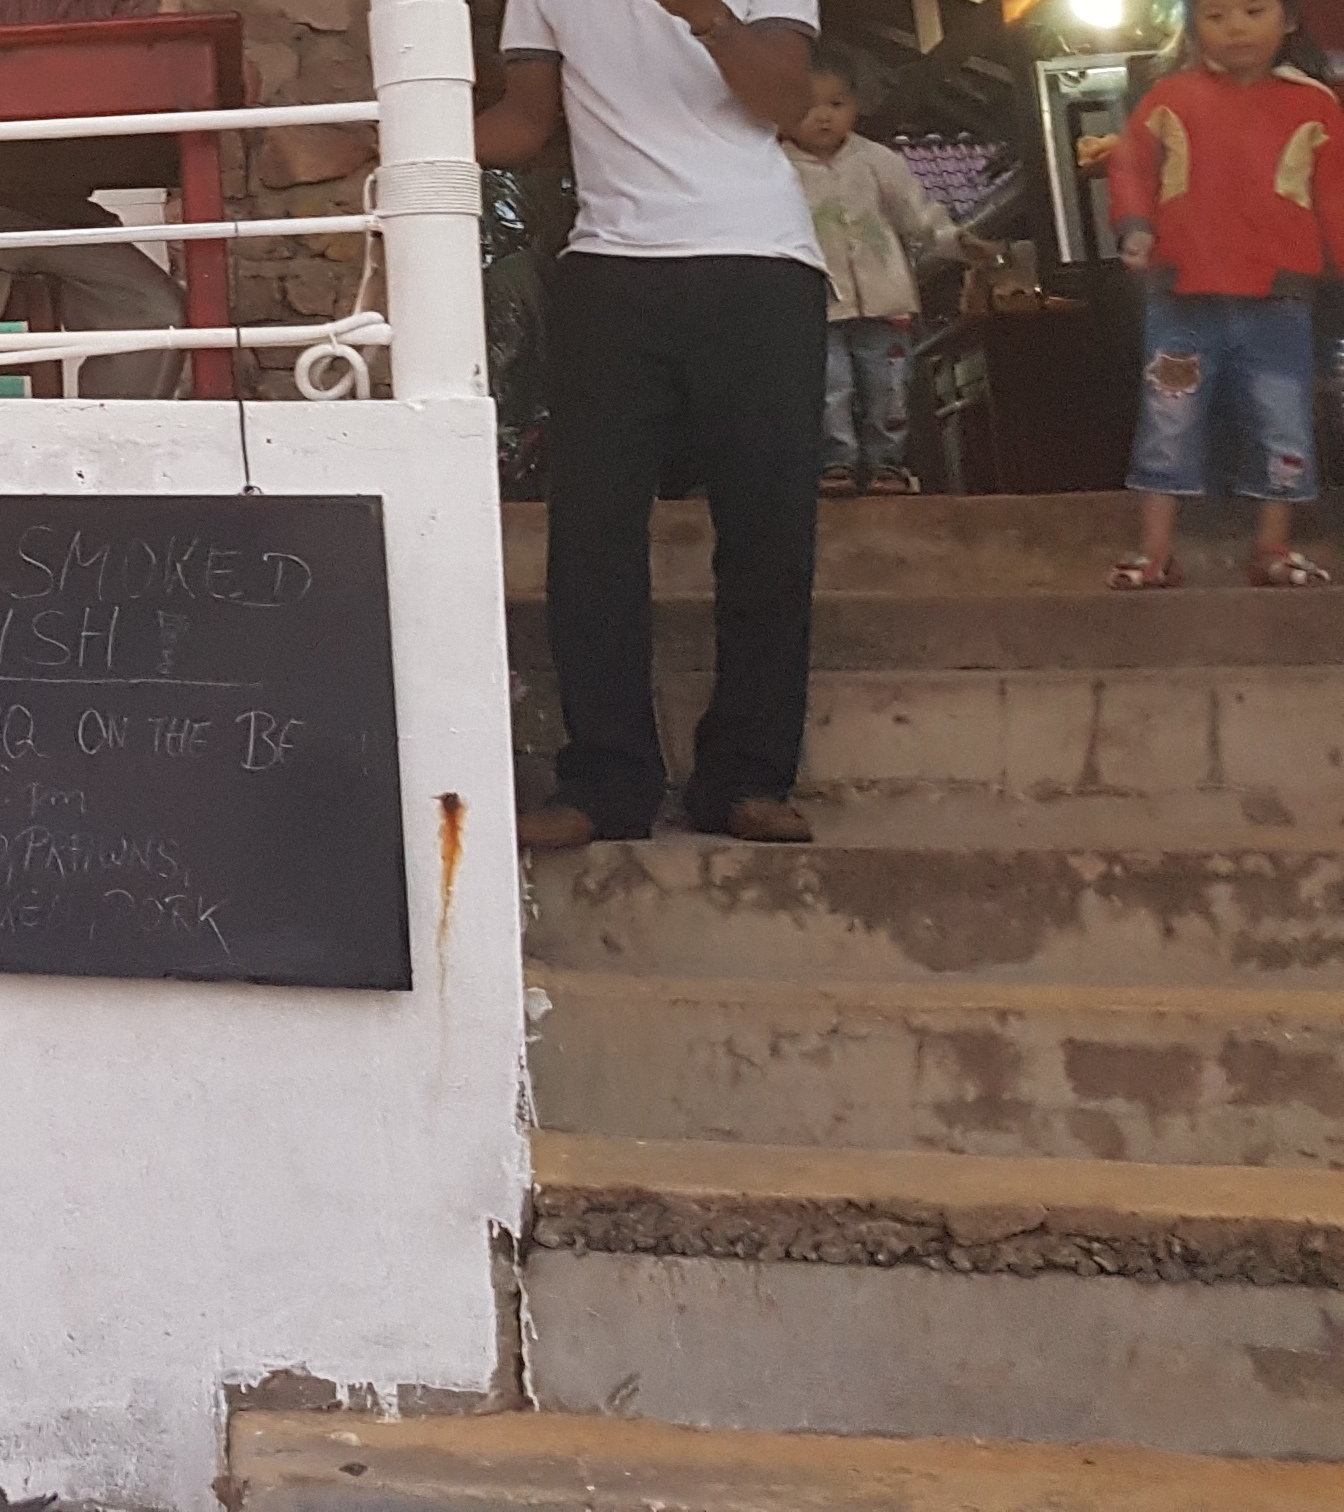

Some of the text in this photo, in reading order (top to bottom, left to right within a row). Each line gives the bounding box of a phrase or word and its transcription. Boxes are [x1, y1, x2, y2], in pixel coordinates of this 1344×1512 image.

[7, 522, 313, 606] SMOKED
[76, 706, 130, 757] ON
[147, 717, 212, 759] THE
